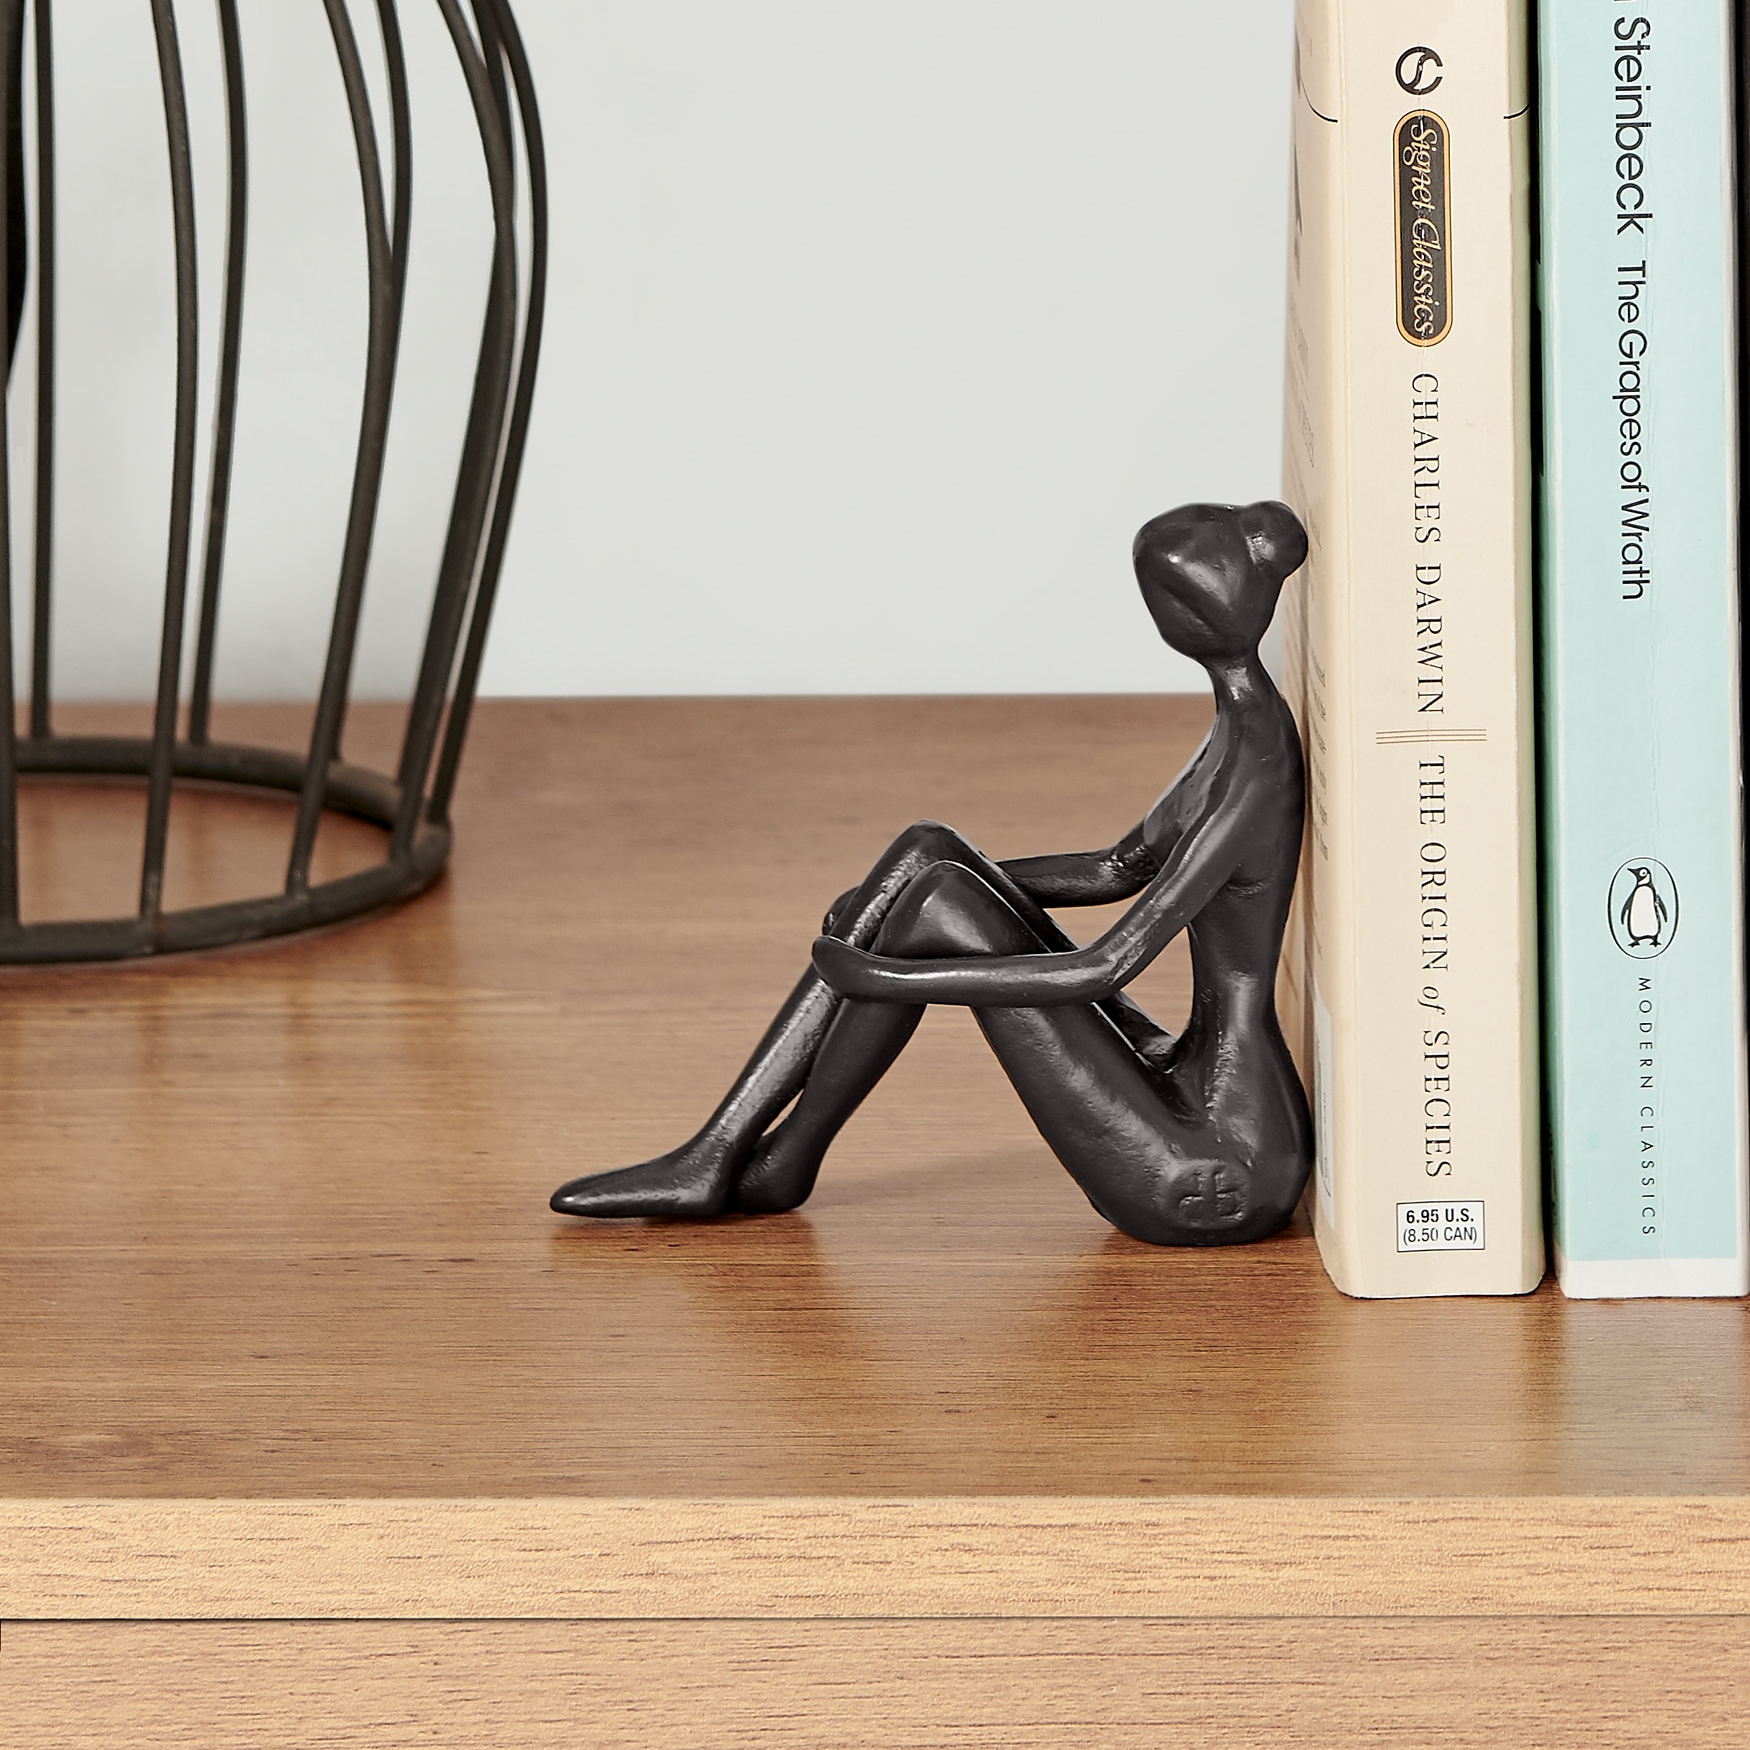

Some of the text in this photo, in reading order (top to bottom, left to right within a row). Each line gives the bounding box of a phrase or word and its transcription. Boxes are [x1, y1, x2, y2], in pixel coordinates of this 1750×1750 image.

[1613, 16, 1653, 235] Steinbeck
[1403, 122, 1441, 336] Signet Classics
[1617, 260, 1647, 324] The
[1612, 328, 1648, 457] Grapes
[1621, 461, 1650, 493] of
[1621, 495, 1651, 600] Wrath
[1411, 373, 1453, 1178] CHARLES DARWIN THE ORIGIN of SPECIES
[1637, 977, 1657, 1235] MODERN CLASSICS
[1402, 1226, 1478, 1247] (8.50 CAN)
[1405, 1208, 1475, 1224] 6.95 U.S.
